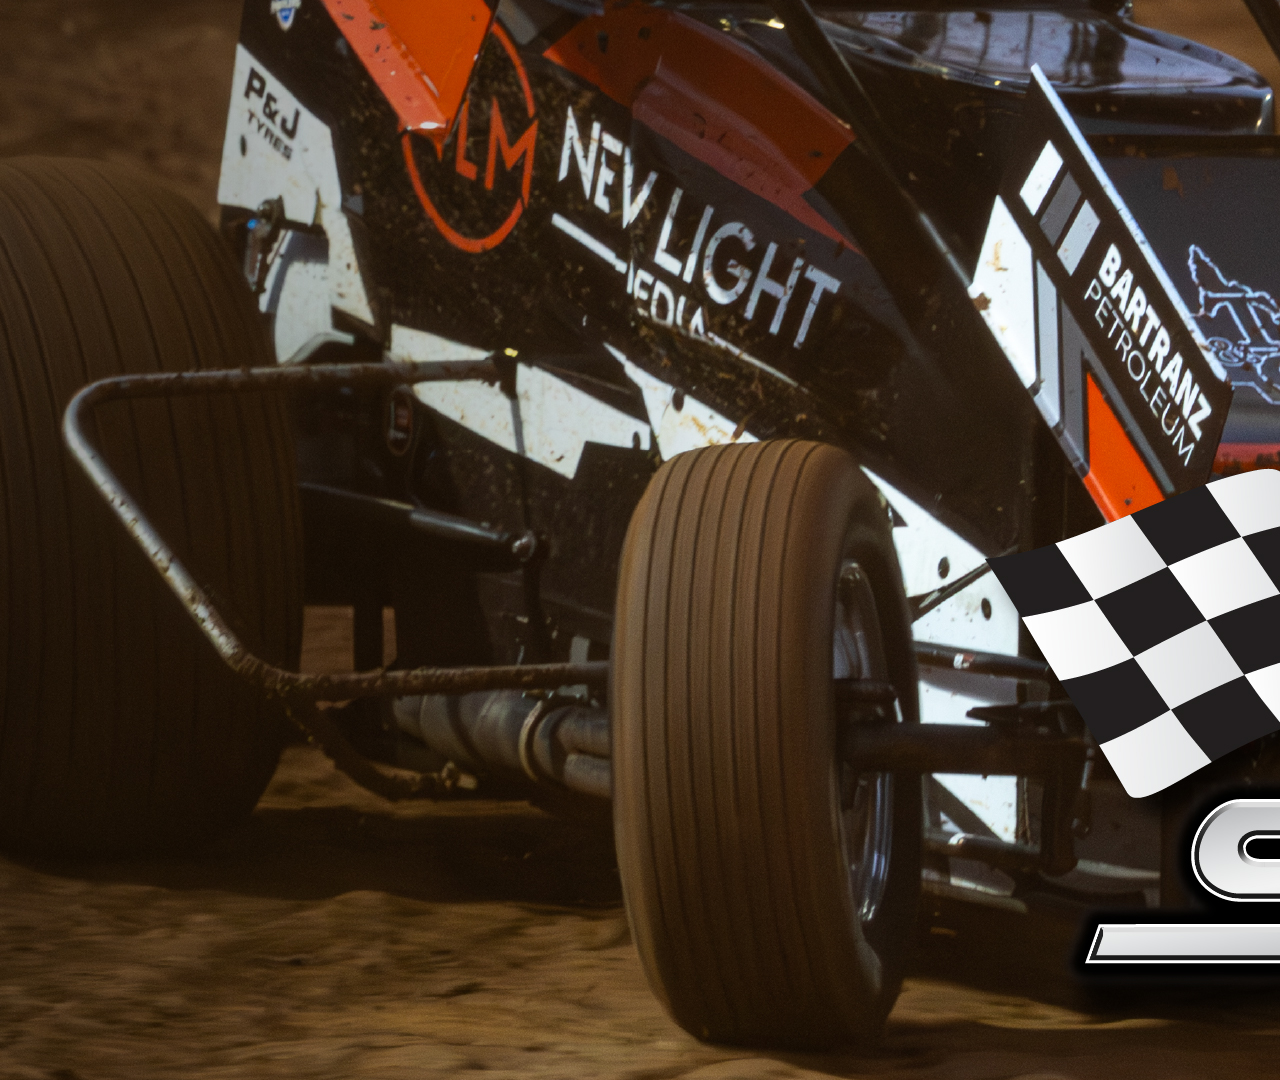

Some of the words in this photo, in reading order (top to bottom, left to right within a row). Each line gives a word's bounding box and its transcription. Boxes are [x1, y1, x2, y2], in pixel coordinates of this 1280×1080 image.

[244, 67, 300, 141] P&J
[248, 109, 293, 161] TYRES
[435, 94, 539, 208] LM
[654, 187, 842, 349] LIGHT
[1084, 278, 1195, 466] PETROLEUM
[1098, 243, 1212, 441] BARTRANZ
